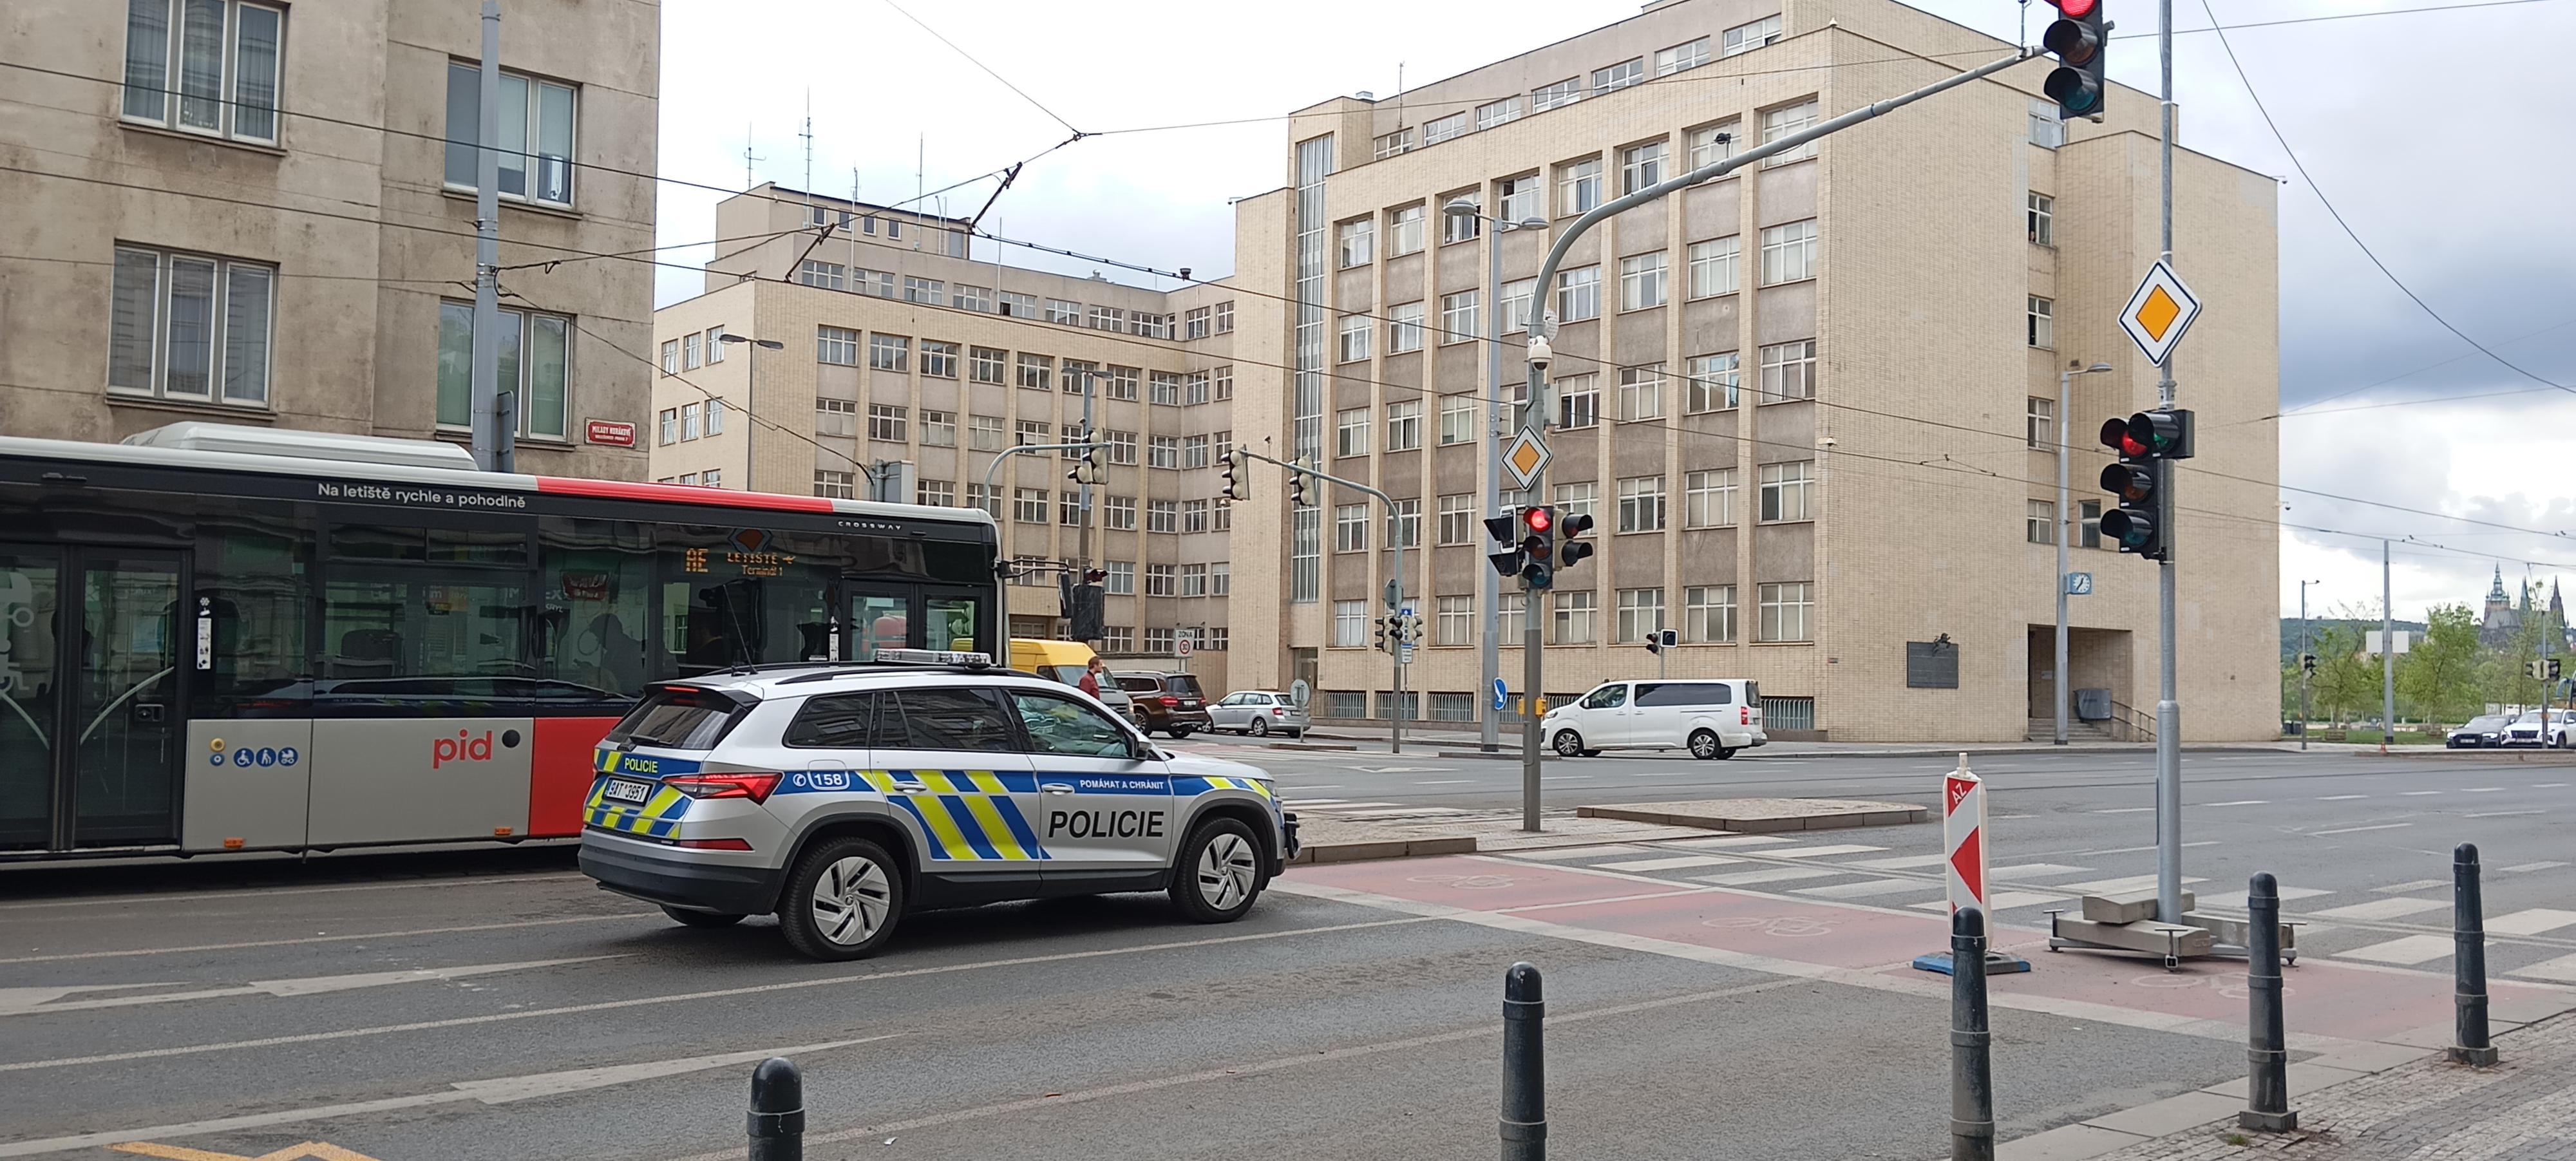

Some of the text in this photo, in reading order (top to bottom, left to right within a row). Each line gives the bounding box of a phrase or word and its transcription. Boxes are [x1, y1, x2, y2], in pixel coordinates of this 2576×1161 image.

[317, 483, 526, 508] Na letiště rychle a pohodlně
[838, 521, 902, 530] CROSSWAY
[685, 548, 709, 573] AE
[433, 728, 493, 769] pid
[625, 757, 658, 773] POLICIE
[814, 773, 842, 786] 158
[1080, 778, 1164, 789] POMÁHAT A CHRÁNIT
[625, 784, 645, 800] 3951
[1951, 782, 1967, 805] AZ
[1048, 810, 1164, 838] POLICIE
